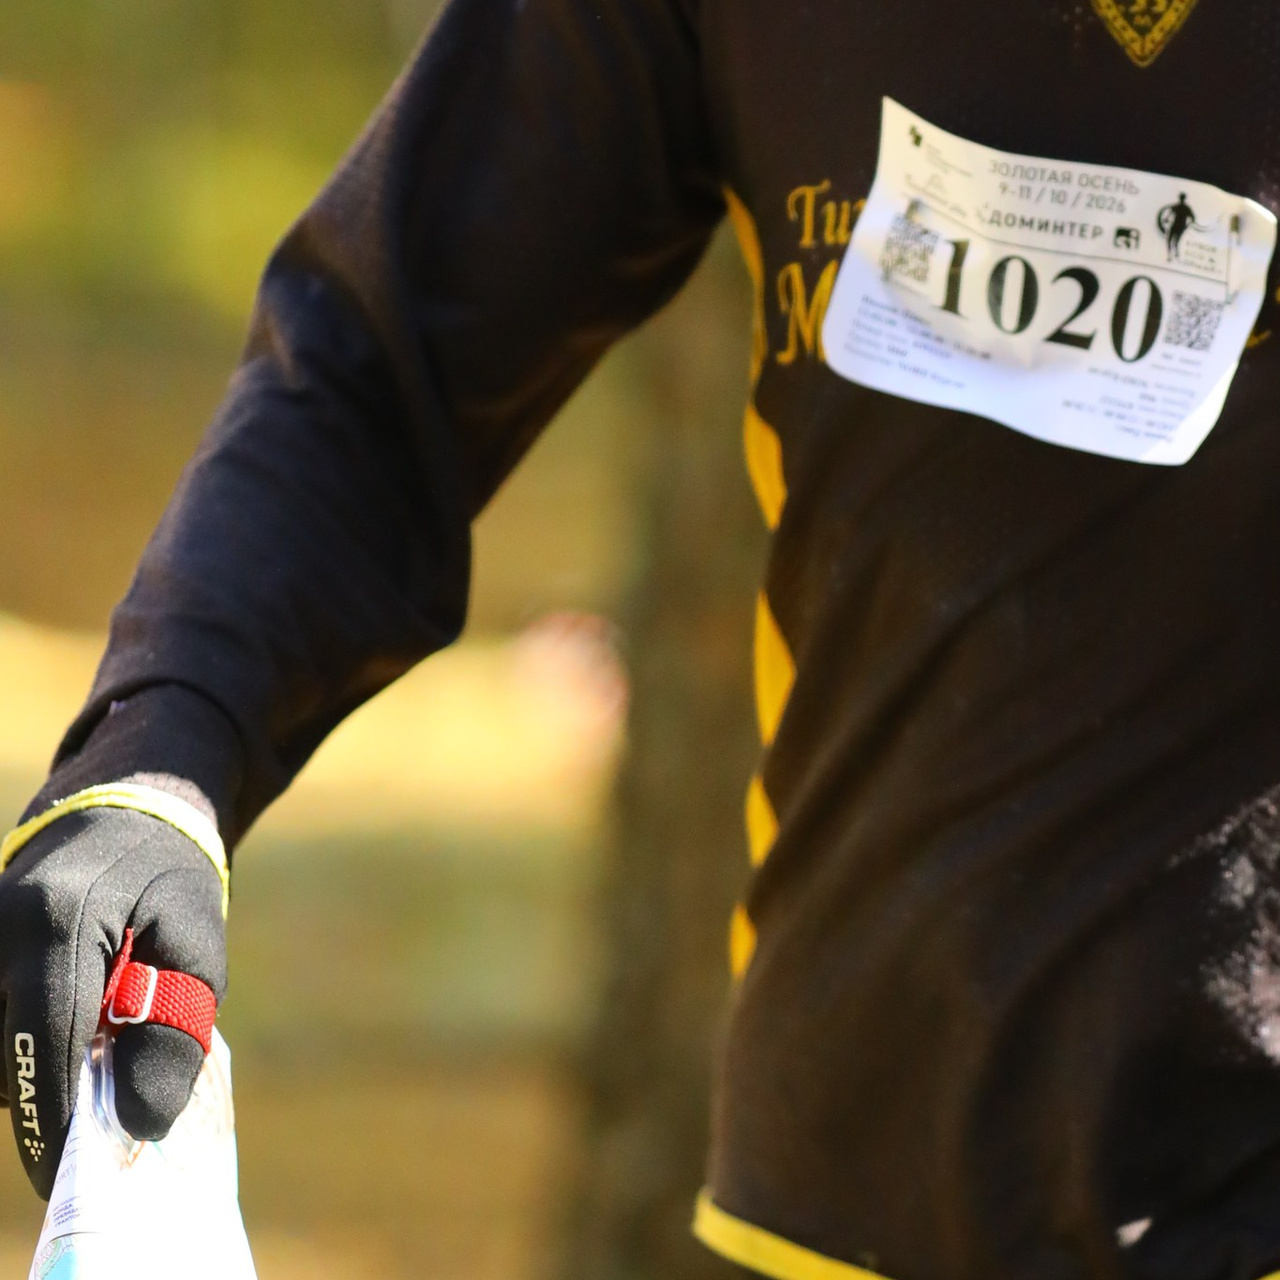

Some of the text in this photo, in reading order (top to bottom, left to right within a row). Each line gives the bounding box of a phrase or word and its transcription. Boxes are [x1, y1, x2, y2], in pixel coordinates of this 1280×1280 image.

[988, 160, 1073, 185] ЗОЛОТАЯ
[1077, 173, 1141, 195] ОСЕНЬ
[786, 178, 866, 248] Tu
[988, 210, 1105, 240] ДОМИНТЕР
[932, 238, 1164, 363] 1020
[14, 1032, 42, 1137] CRAFT
